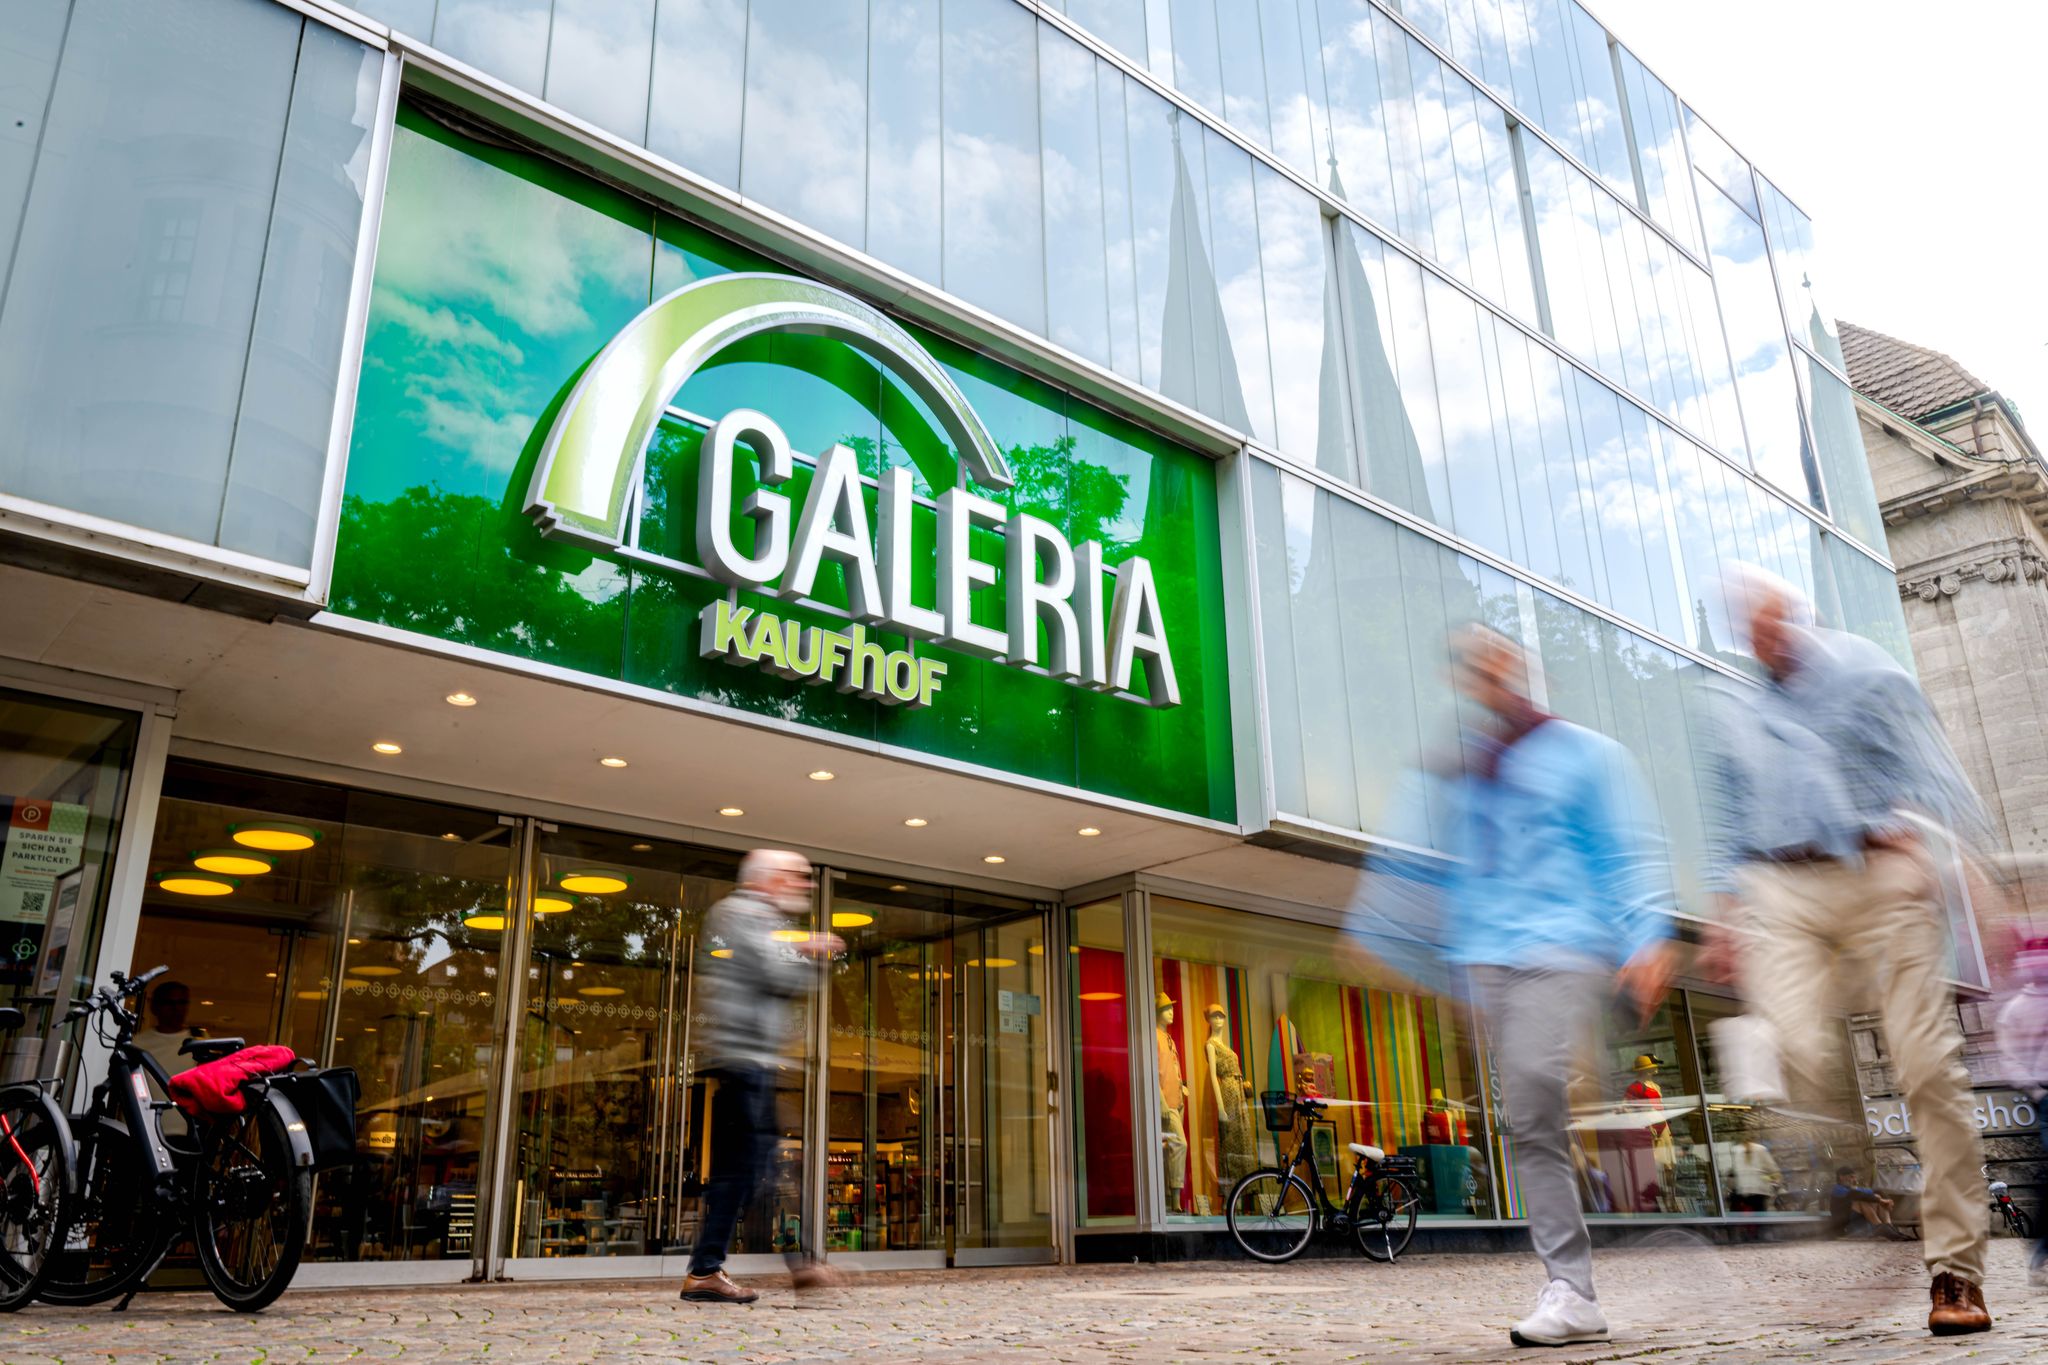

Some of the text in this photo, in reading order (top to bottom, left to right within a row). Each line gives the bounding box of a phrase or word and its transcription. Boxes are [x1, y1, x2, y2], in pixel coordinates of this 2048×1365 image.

[700, 408, 1181, 709] GALERIA
[20, 831, 55, 842] SPAREN
[21, 842, 67, 854] SICH DAS
[11, 851, 72, 864] PARKTICKET:
